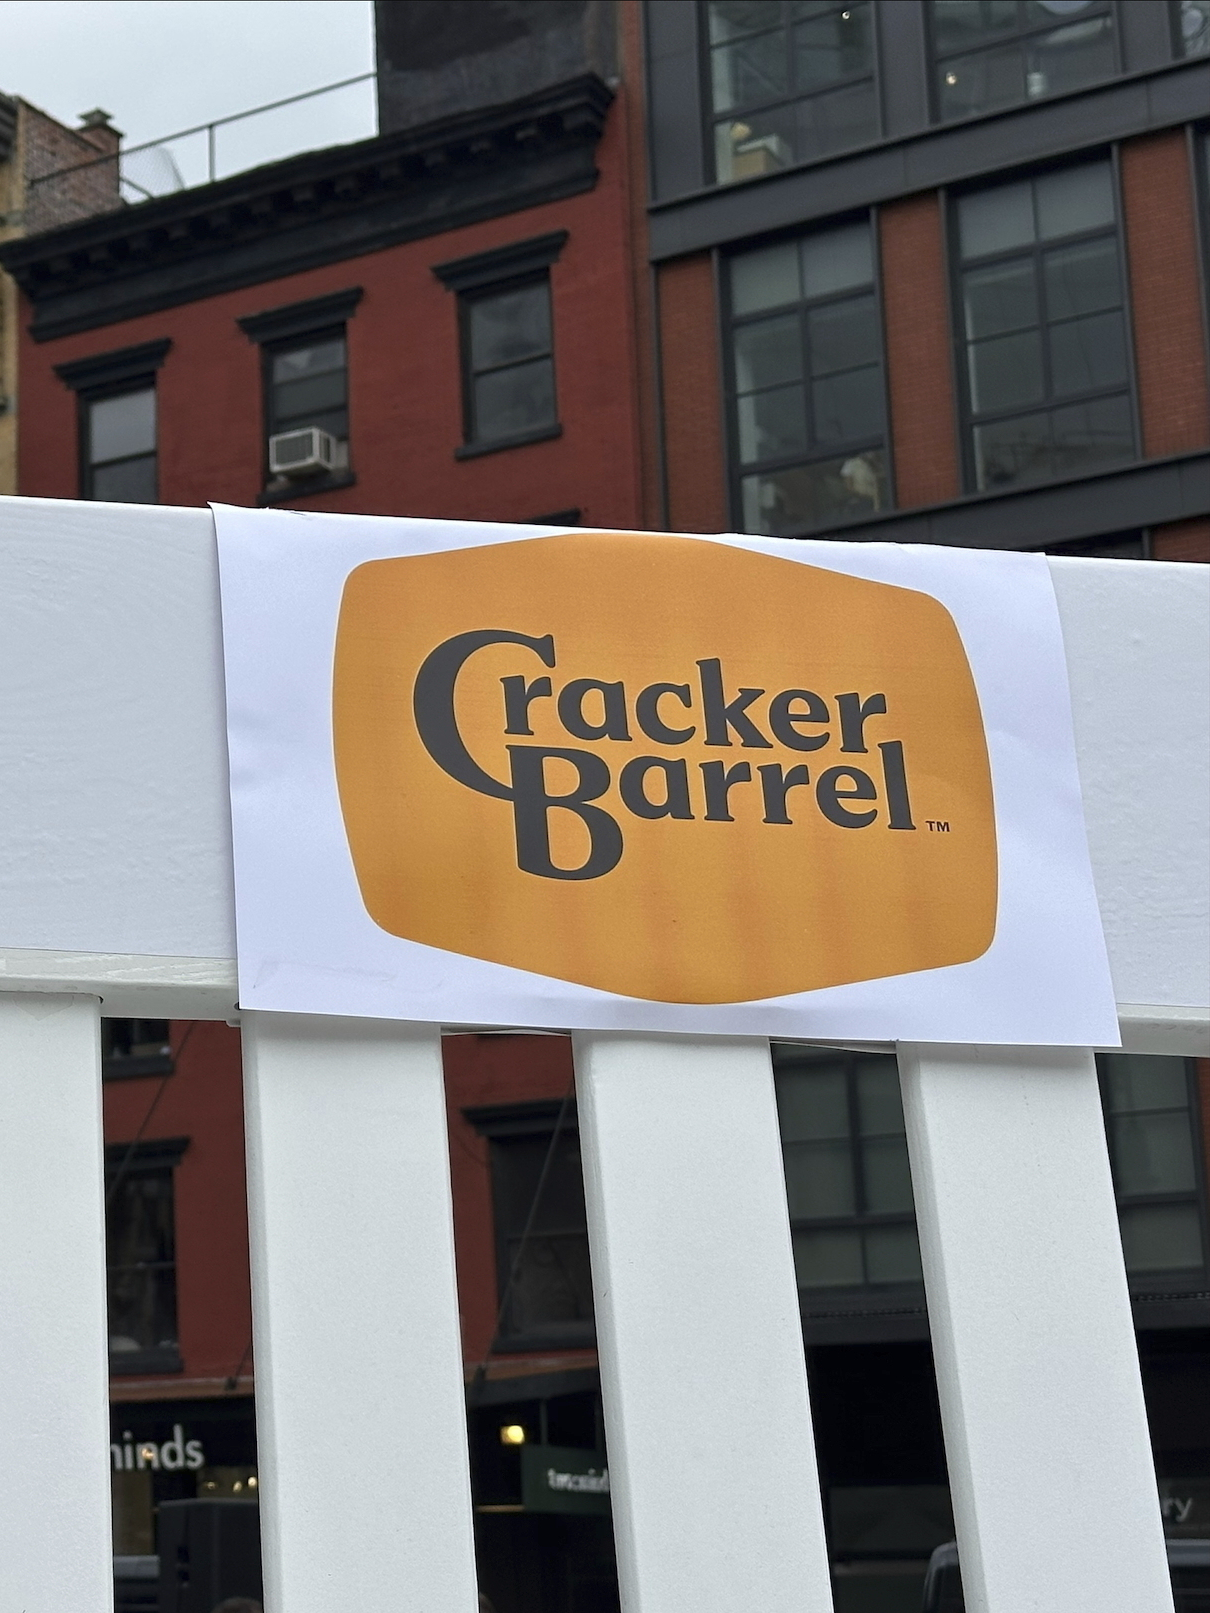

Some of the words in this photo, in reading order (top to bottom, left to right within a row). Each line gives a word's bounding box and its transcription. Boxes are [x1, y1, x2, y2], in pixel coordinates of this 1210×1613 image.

[412, 629, 887, 801] Cracker
[505, 740, 916, 880] Barrel
[925, 820, 950, 832] TM
